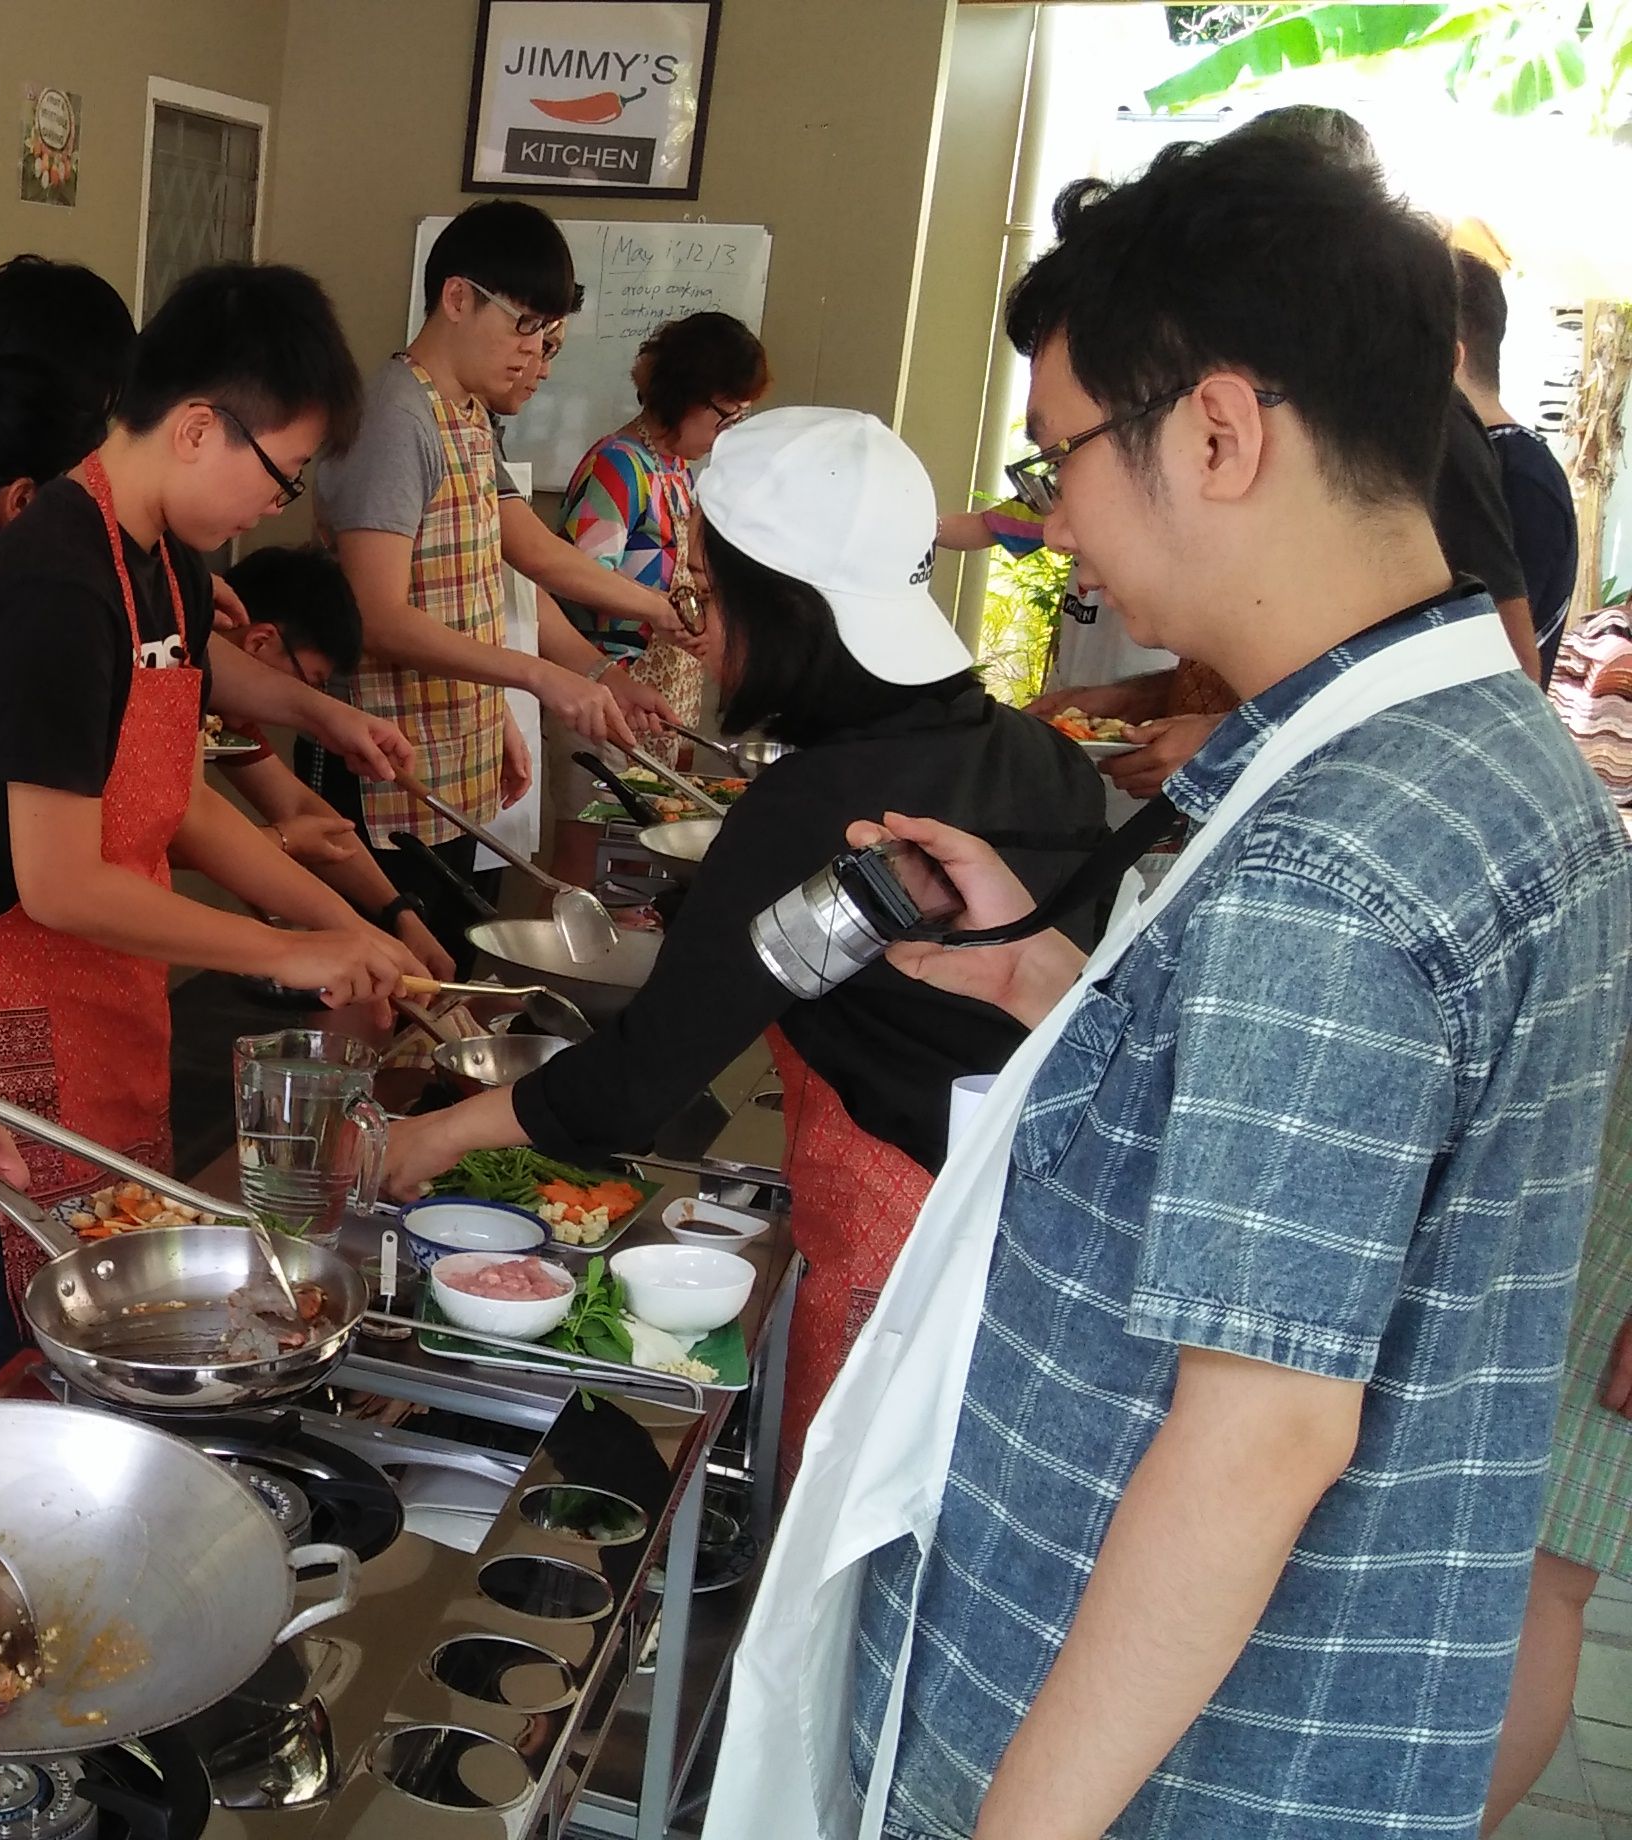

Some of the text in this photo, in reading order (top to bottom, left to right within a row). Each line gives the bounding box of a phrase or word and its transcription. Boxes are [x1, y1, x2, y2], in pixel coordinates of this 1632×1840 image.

[505, 45, 680, 86] JIMMY'S
[520, 142, 639, 171] KITCHEN
[611, 235, 655, 267] May
[621, 284, 662, 300] group
